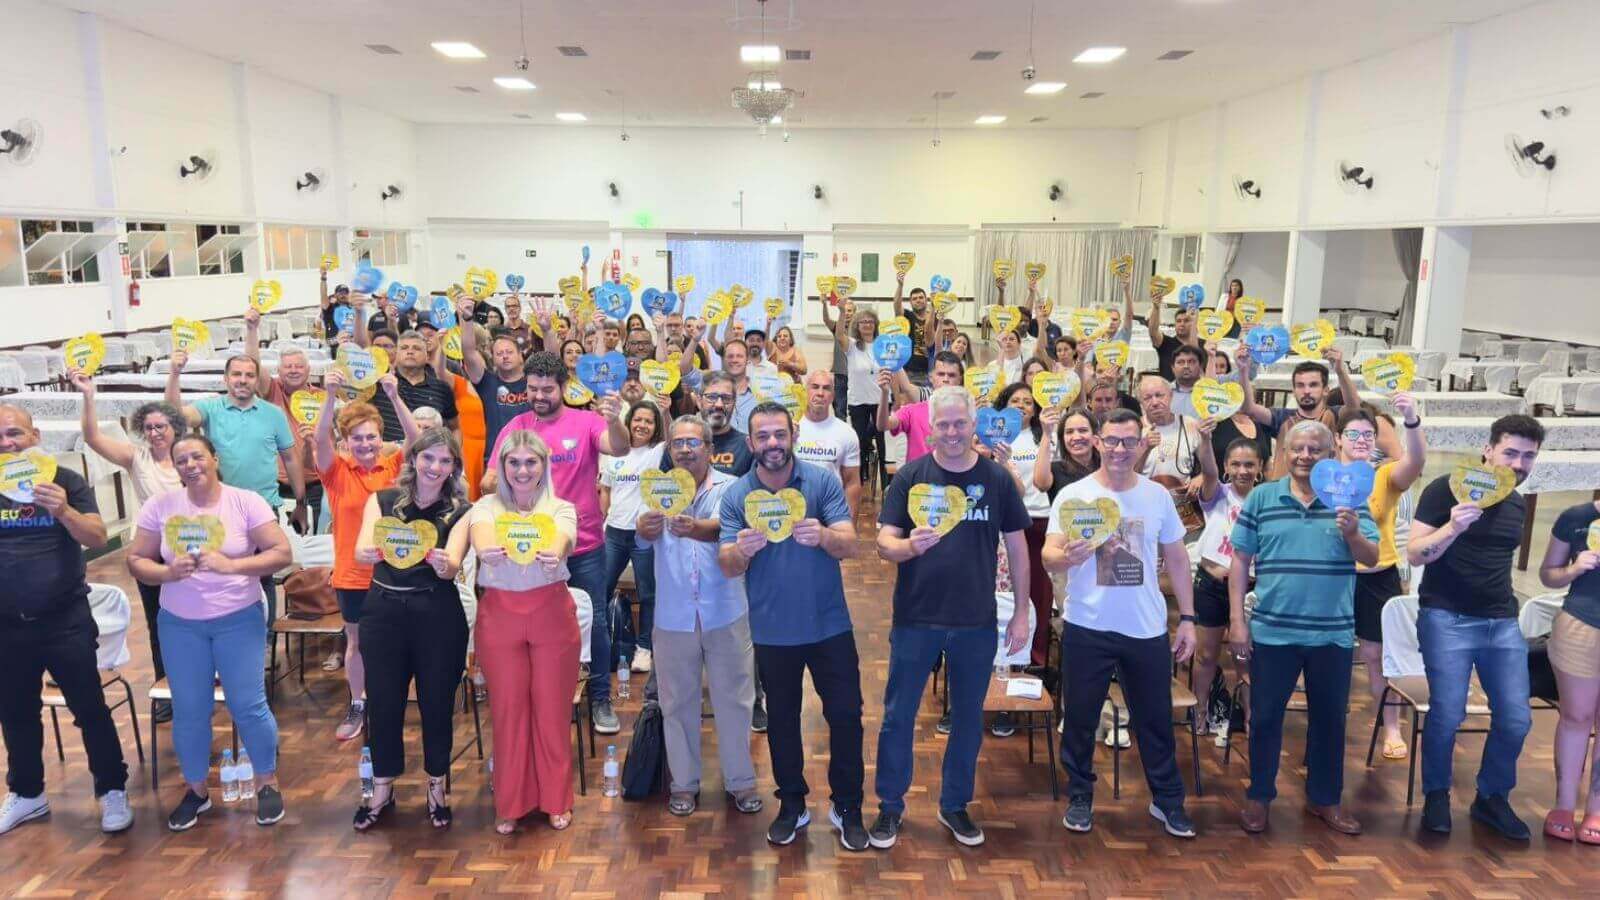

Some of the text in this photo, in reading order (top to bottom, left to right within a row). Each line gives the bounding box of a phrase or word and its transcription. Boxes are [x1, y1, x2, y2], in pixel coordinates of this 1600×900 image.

[797, 445, 837, 456] JUNDIAÍ
[710, 452, 734, 463] VO
[615, 473, 640, 482] JUNDI
[0, 509, 20, 519] EU
